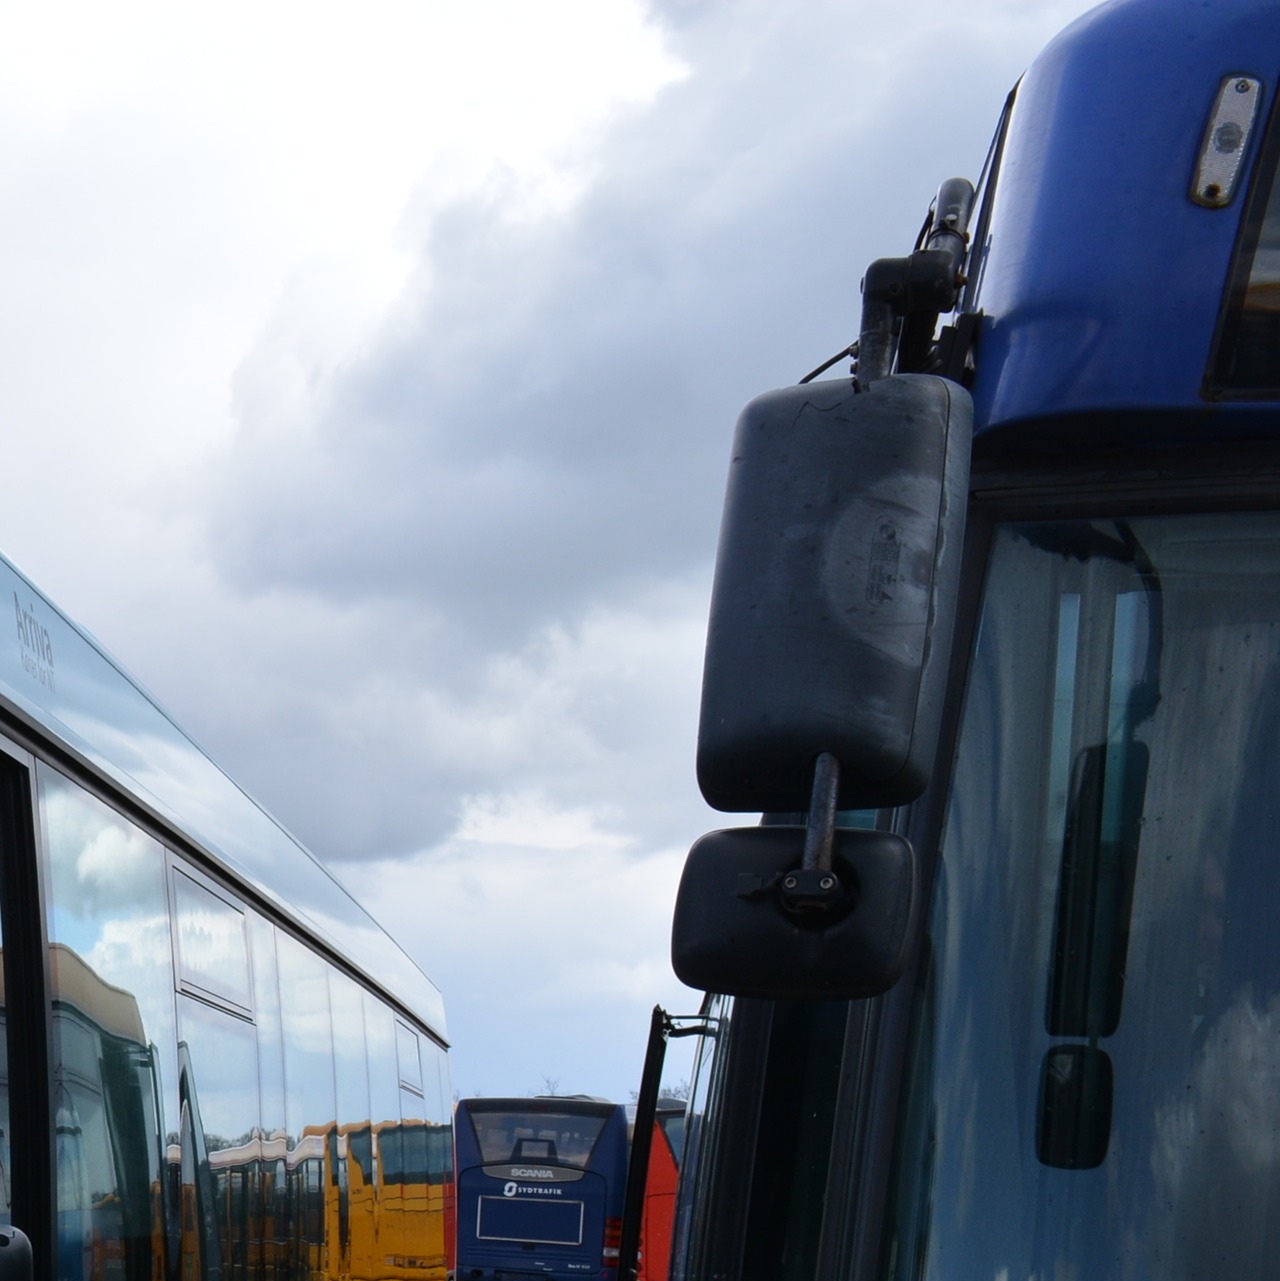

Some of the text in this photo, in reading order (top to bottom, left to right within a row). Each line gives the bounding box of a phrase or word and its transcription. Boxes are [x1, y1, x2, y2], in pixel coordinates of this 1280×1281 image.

[13, 591, 54, 668] Arriva
[511, 1168, 554, 1179] SCANIA
[517, 1186, 562, 1195] SYDTRAFIK
